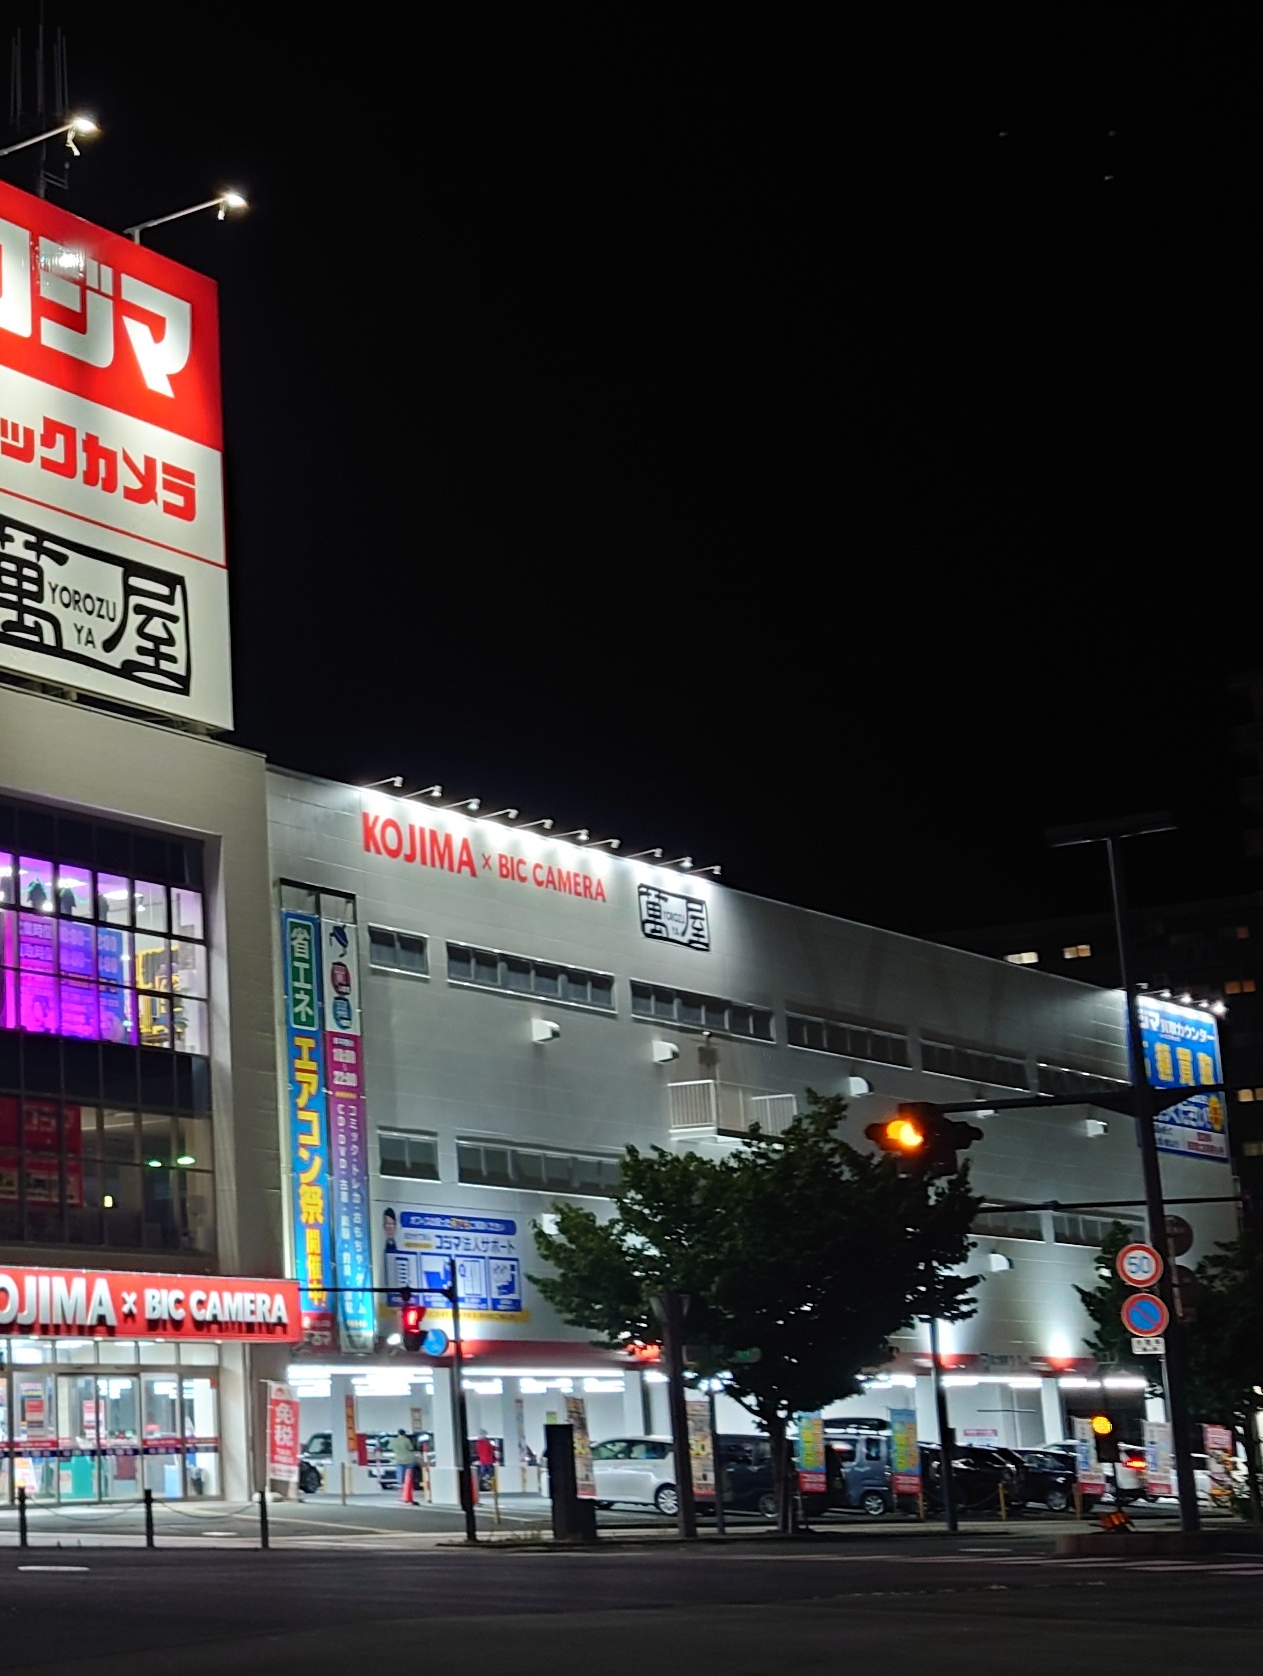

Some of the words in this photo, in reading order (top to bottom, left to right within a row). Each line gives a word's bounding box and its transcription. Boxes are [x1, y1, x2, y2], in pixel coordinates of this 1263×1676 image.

[47, 580, 117, 624] YOROZU
[73, 622, 97, 650] YA
[361, 810, 478, 878] KOJIMA
[498, 852, 528, 883] BIC
[532, 861, 607, 902] CAMERA
[291, 926, 314, 1022] 省エネ
[1128, 1256, 1152, 1274] 50
[144, 1289, 185, 1322] BIC
[190, 1291, 289, 1324] CAMERA
[274, 1403, 294, 1447] 免税
